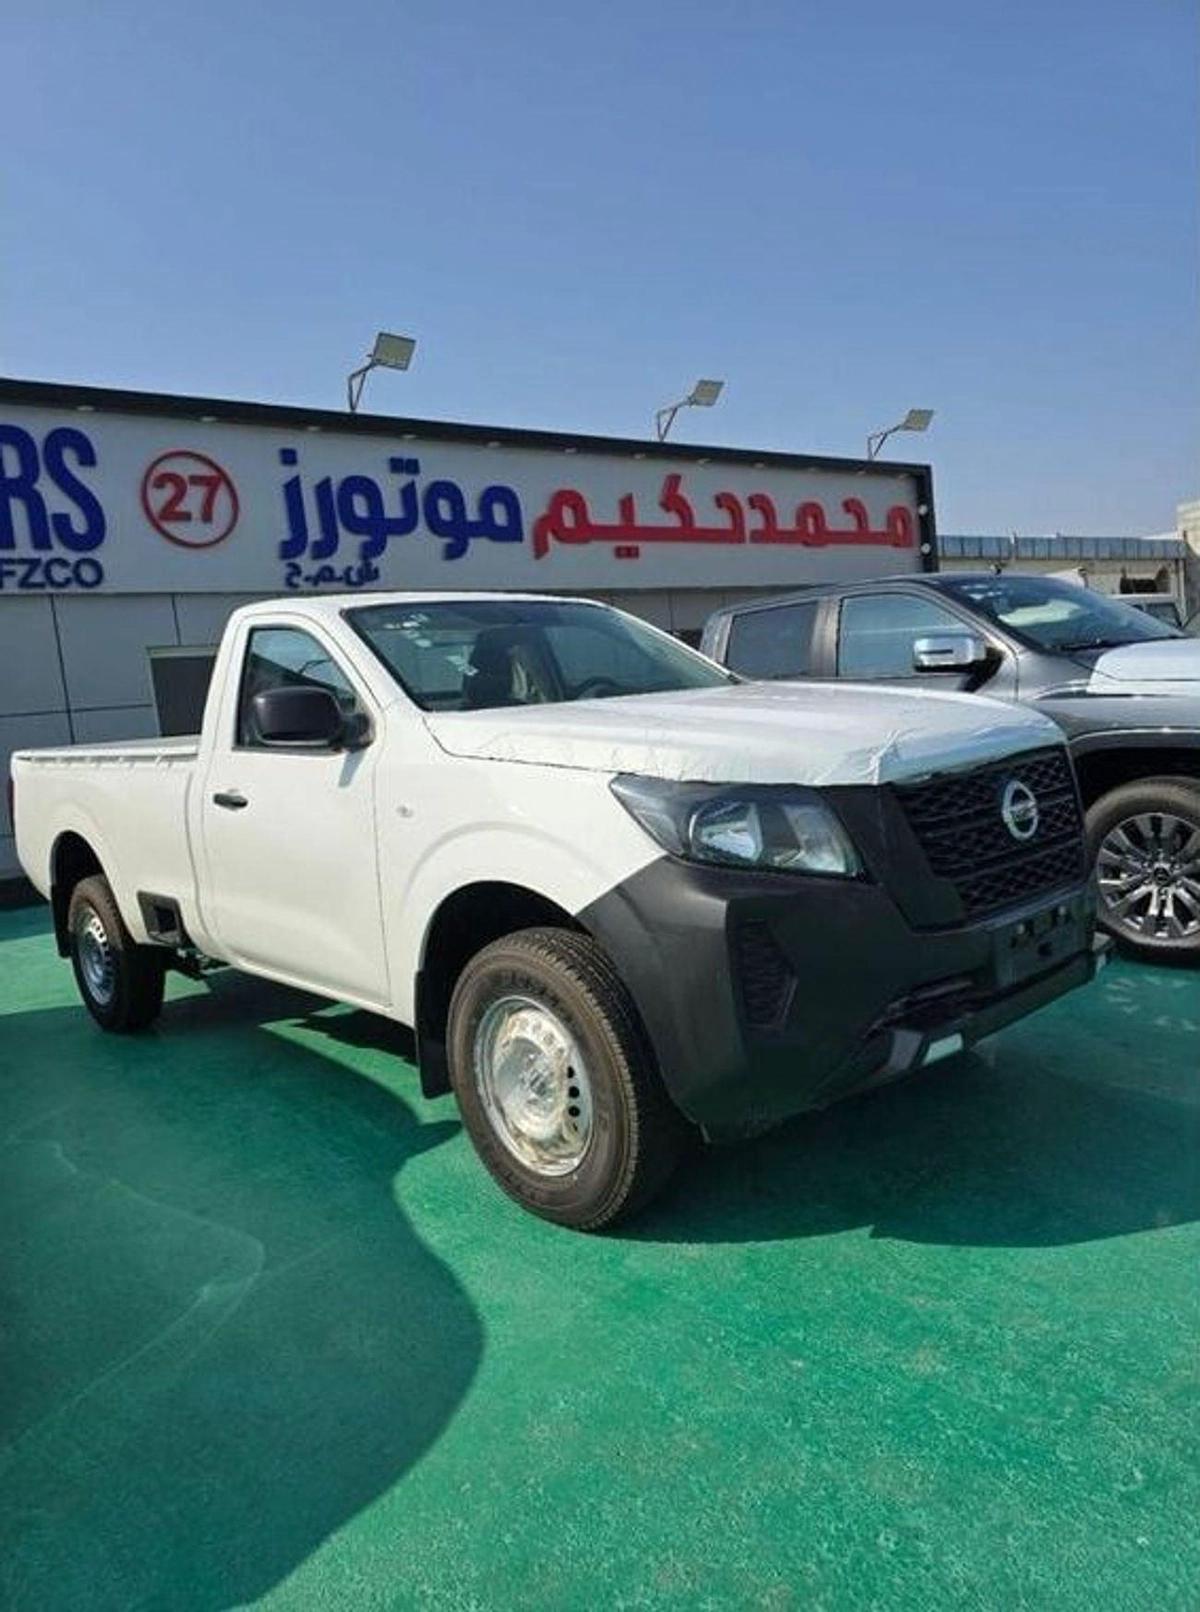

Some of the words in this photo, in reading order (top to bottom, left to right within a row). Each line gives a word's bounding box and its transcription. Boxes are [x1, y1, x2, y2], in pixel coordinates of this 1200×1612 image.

[153, 473, 221, 523] 27
[280, 448, 523, 560] موتورز
[0, 557, 104, 588] FZCO
